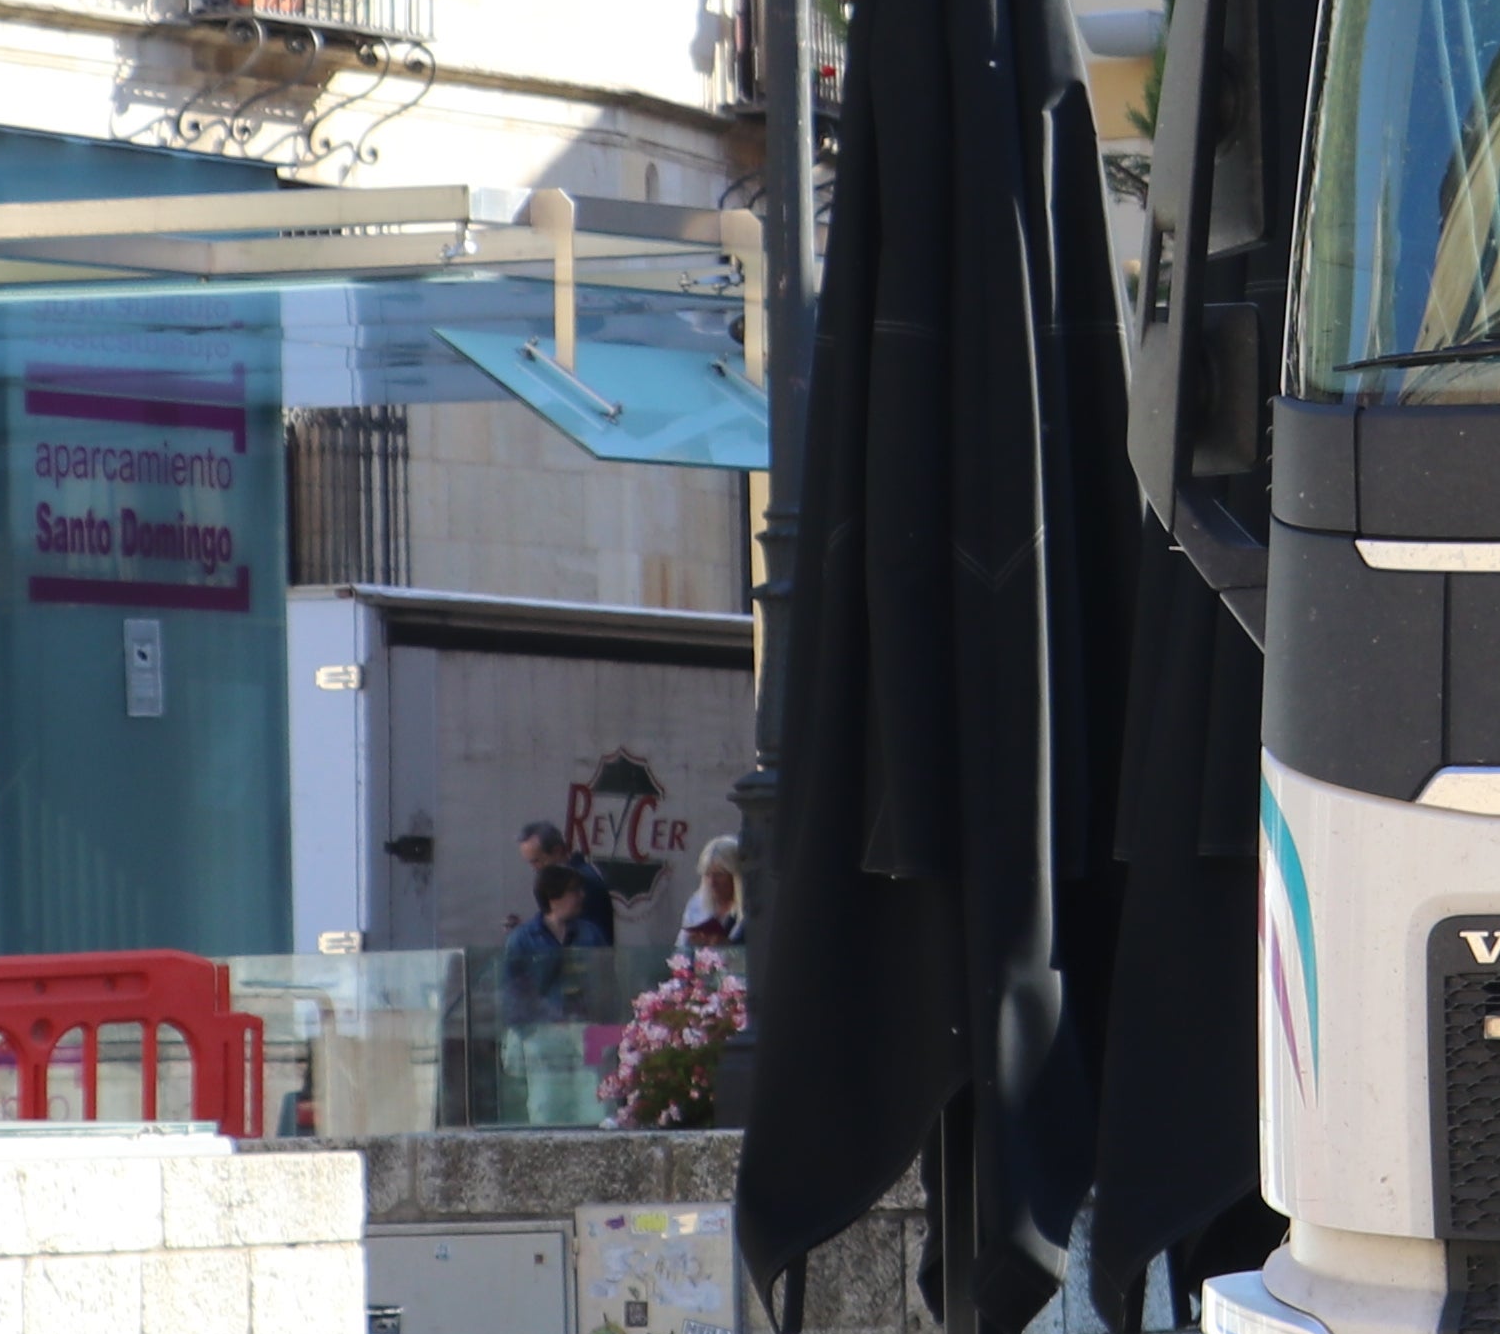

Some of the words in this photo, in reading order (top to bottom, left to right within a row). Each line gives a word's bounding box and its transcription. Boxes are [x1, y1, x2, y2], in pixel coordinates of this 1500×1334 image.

[35, 440, 232, 489] aparcamiento
[36, 501, 112, 556] Santo
[120, 507, 233, 575] Domingo
